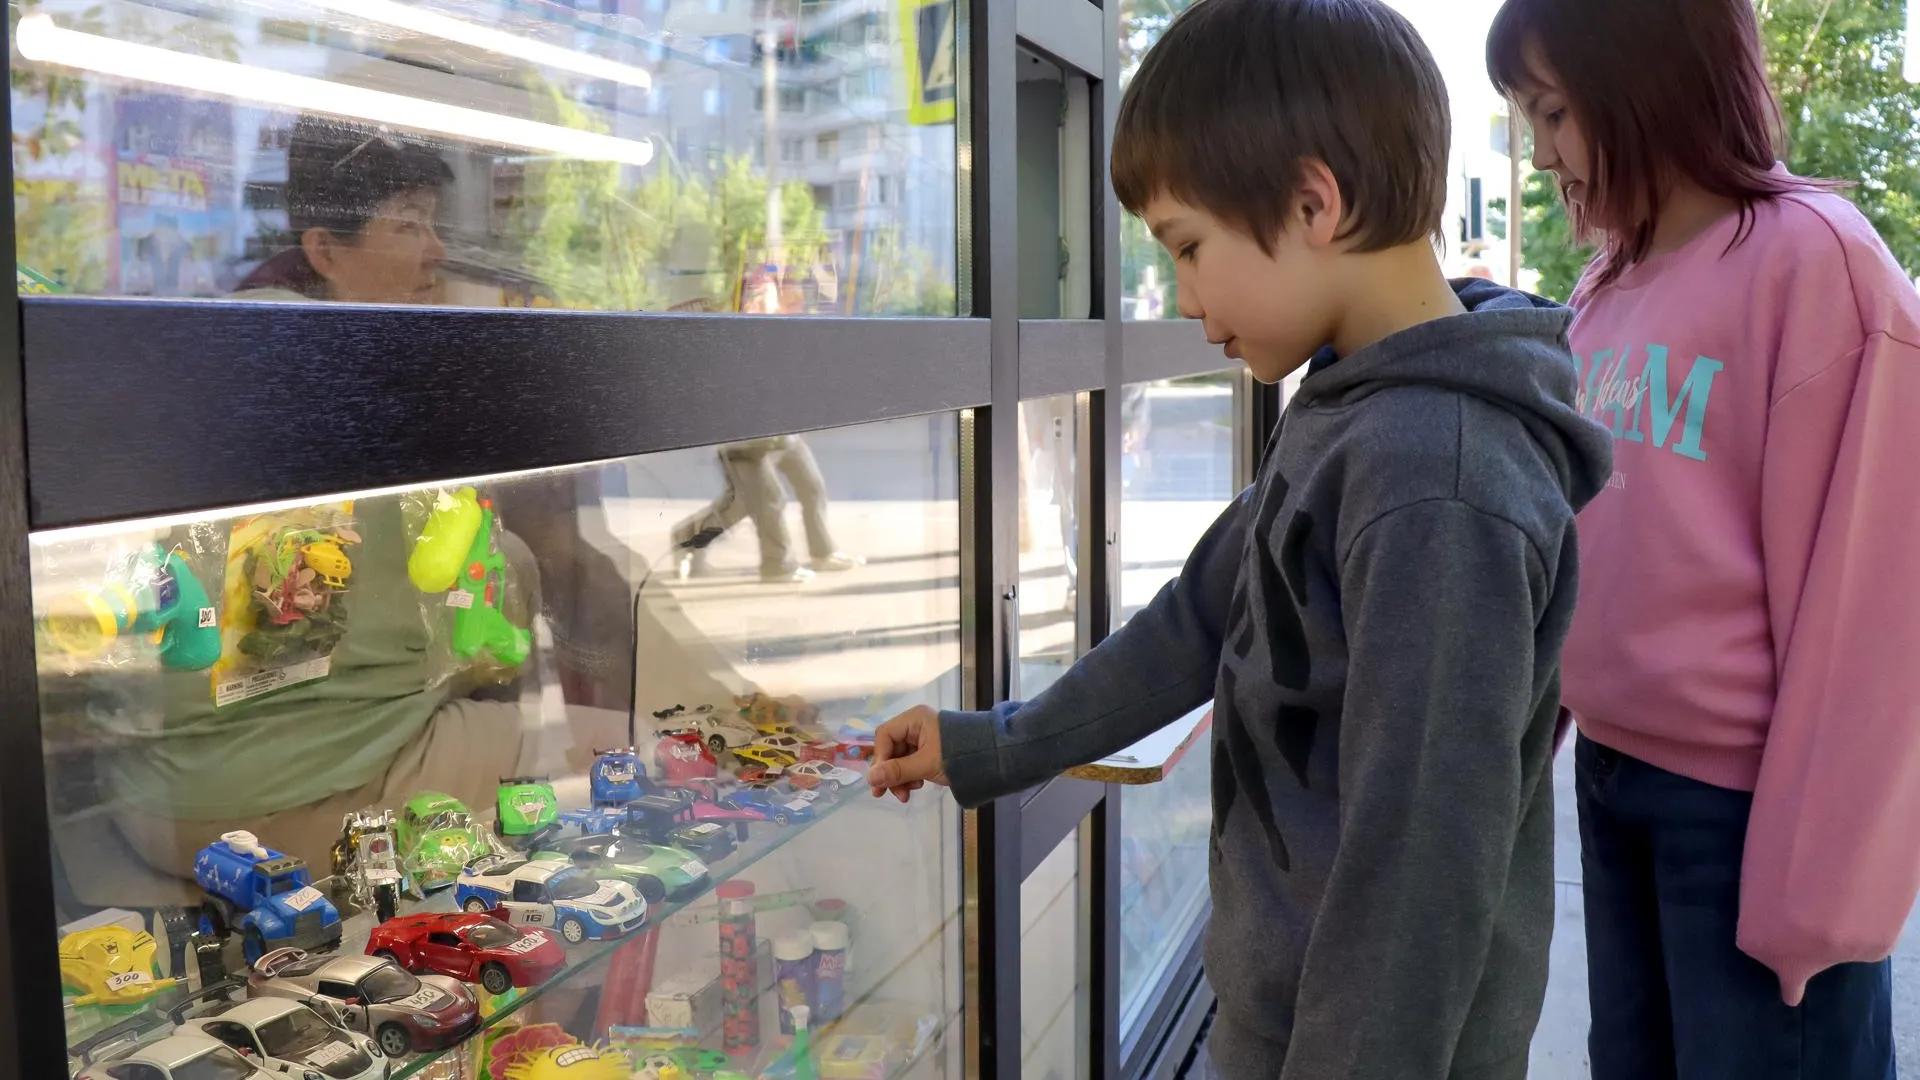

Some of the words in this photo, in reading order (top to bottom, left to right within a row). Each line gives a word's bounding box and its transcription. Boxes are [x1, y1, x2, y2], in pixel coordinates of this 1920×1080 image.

[1573, 343, 1724, 462] EAM
[525, 914, 543, 922] 16
[114, 973, 140, 985] 300
[411, 991, 435, 1007] 450
